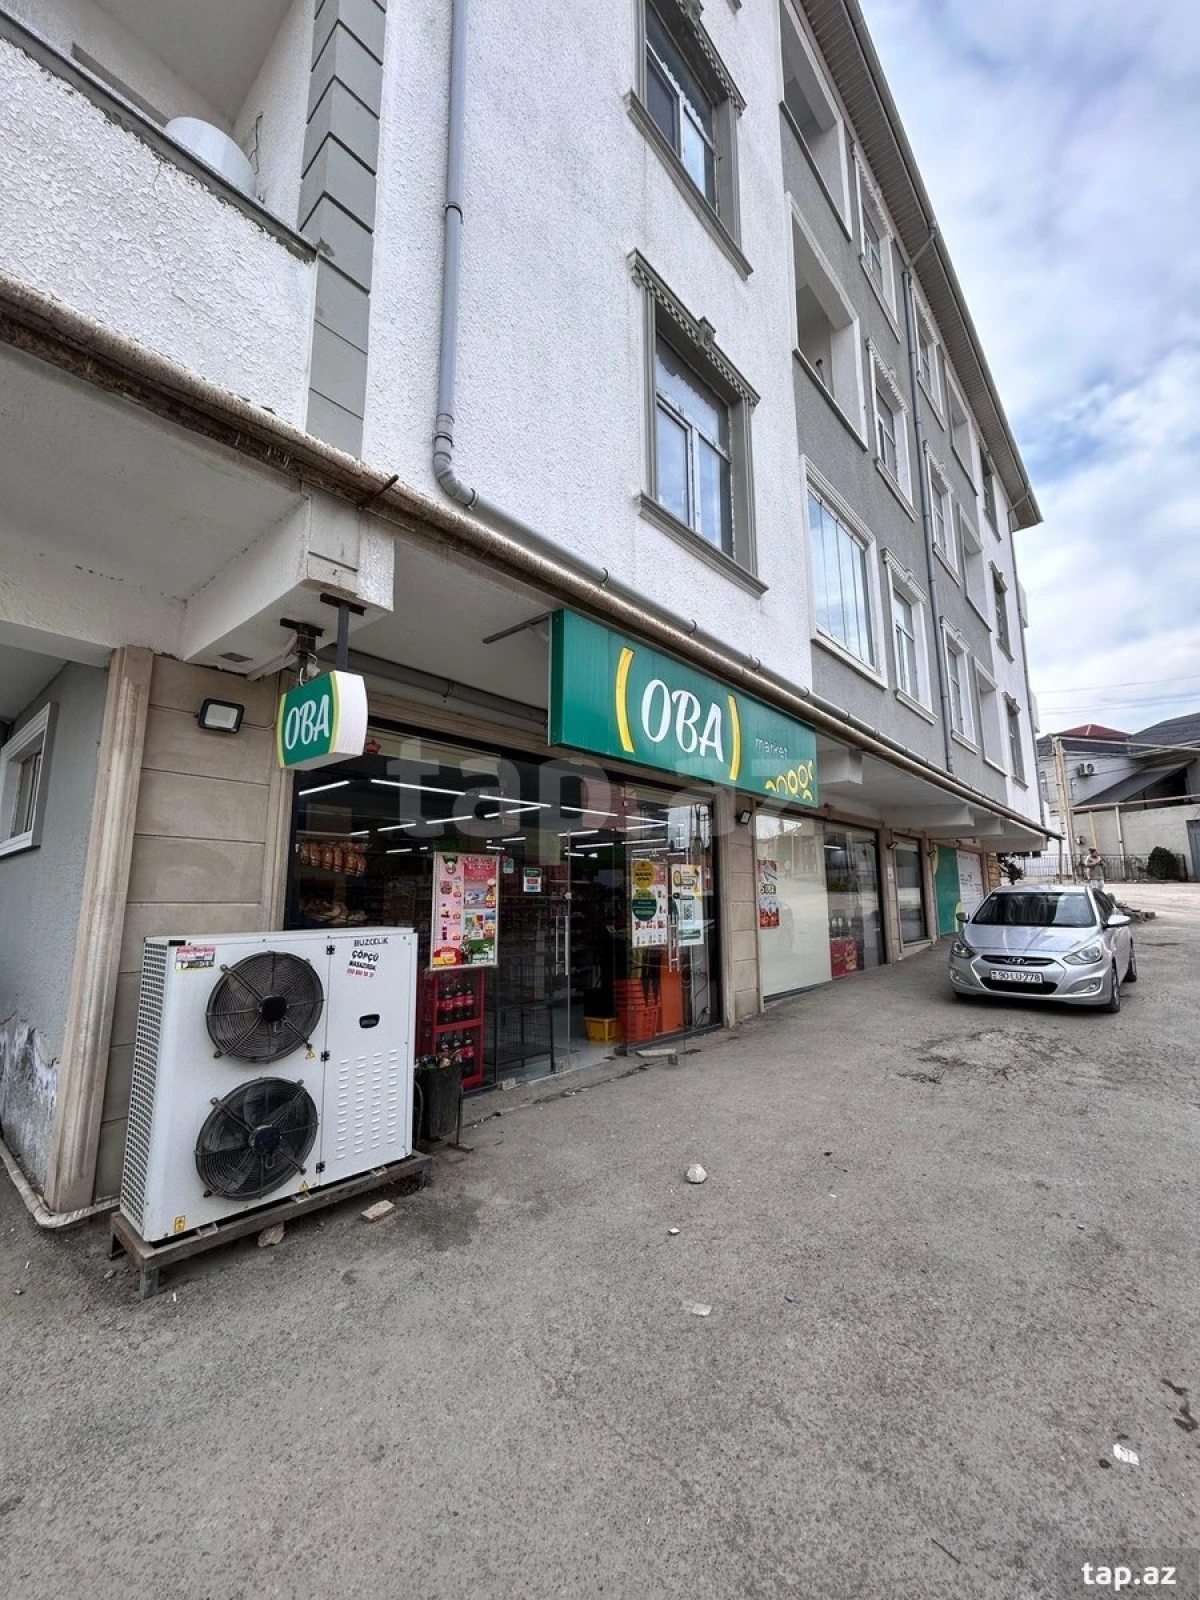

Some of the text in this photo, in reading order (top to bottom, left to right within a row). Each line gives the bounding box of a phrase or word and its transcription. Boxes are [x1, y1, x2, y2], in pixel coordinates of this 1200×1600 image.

[284, 694, 330, 750] OBA
[641, 679, 725, 763] OBA
[755, 738, 788, 760] market
